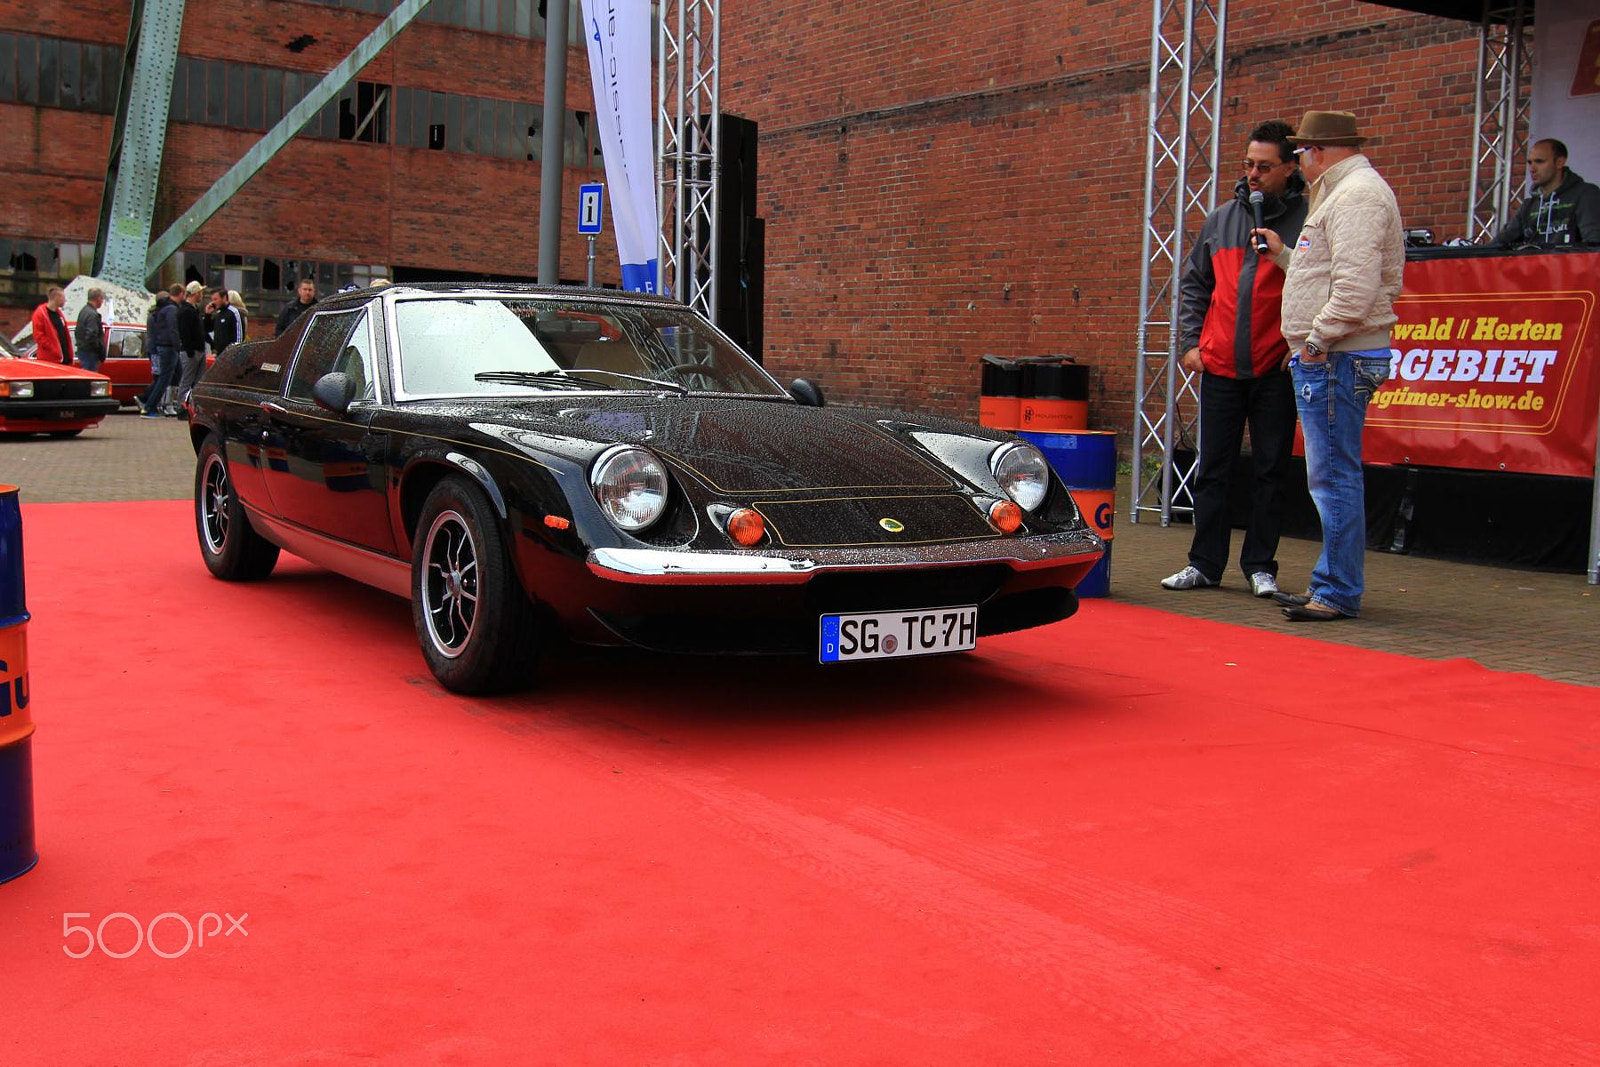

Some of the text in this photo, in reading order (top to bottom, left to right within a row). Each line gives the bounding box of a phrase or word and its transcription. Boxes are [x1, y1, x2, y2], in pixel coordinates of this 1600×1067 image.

[1390, 317, 1455, 341] wald
[1471, 317, 1564, 341] Herten
[826, 643, 834, 654] D
[840, 619, 879, 655] SG
